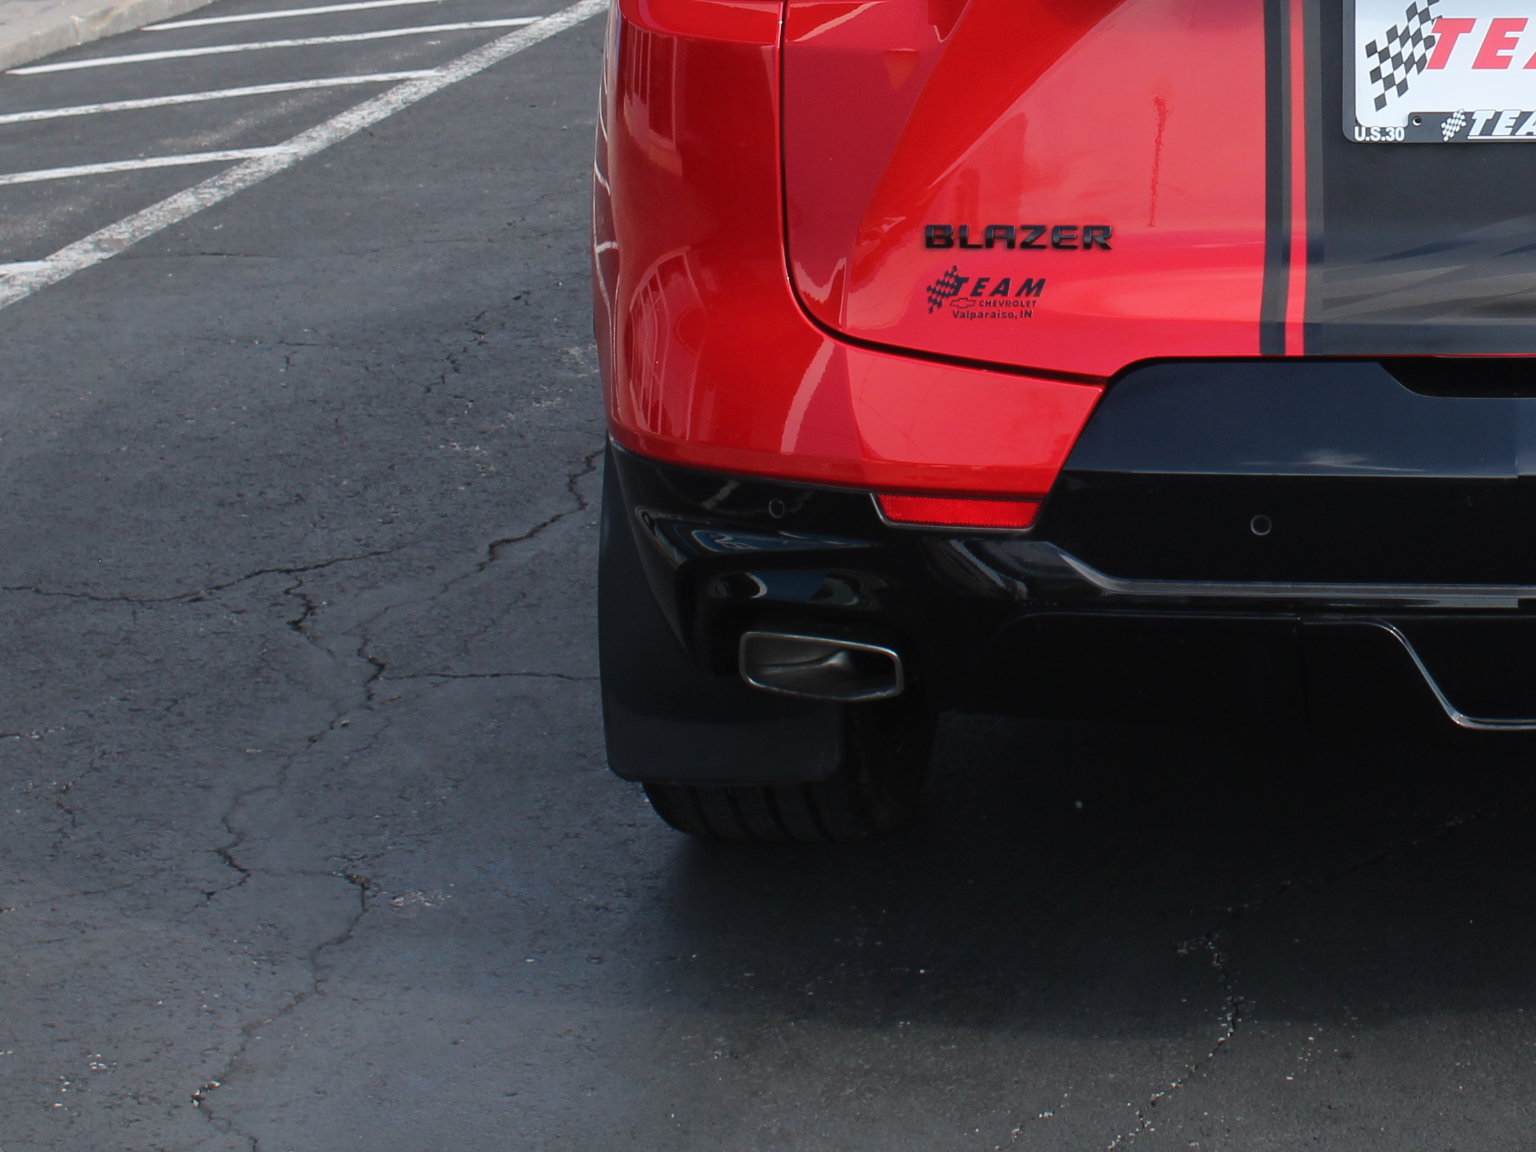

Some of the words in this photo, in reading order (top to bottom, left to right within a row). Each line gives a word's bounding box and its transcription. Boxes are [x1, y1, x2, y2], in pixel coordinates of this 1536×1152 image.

[925, 224, 1113, 250] BLAZER
[951, 276, 1047, 297] TEAM
[978, 299, 1037, 308] CHEVROLET
[953, 309, 1018, 320] Valparaiso,
[1020, 309, 1033, 318] IN
